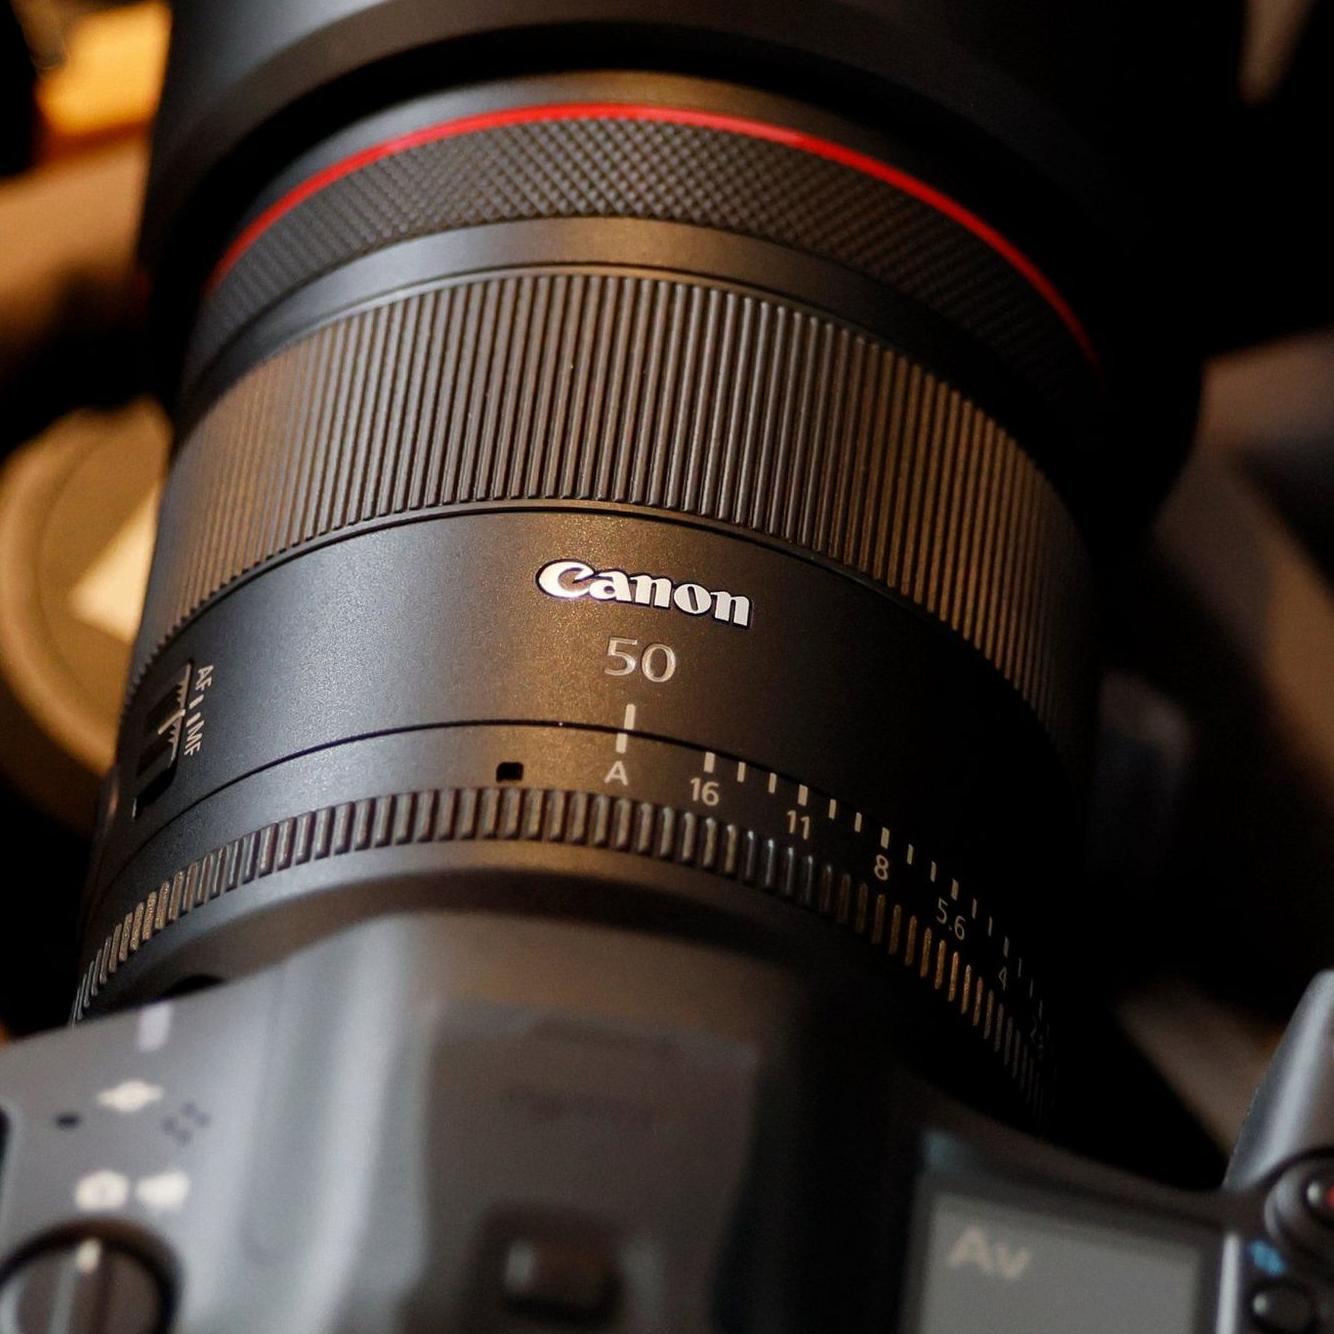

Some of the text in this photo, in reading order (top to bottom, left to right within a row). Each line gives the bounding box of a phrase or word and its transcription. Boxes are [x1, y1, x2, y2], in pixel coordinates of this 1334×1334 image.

[537, 559, 752, 628] Canon
[195, 665, 214, 691] AF
[604, 636, 677, 683] 50
[184, 719, 205, 756] MF
[603, 760, 629, 786] A
[690, 777, 720, 806] 16
[786, 809, 811, 841] 11
[873, 853, 890, 881] 8
[935, 896, 967, 941] 5.6
[947, 1225, 1034, 1281] Av
